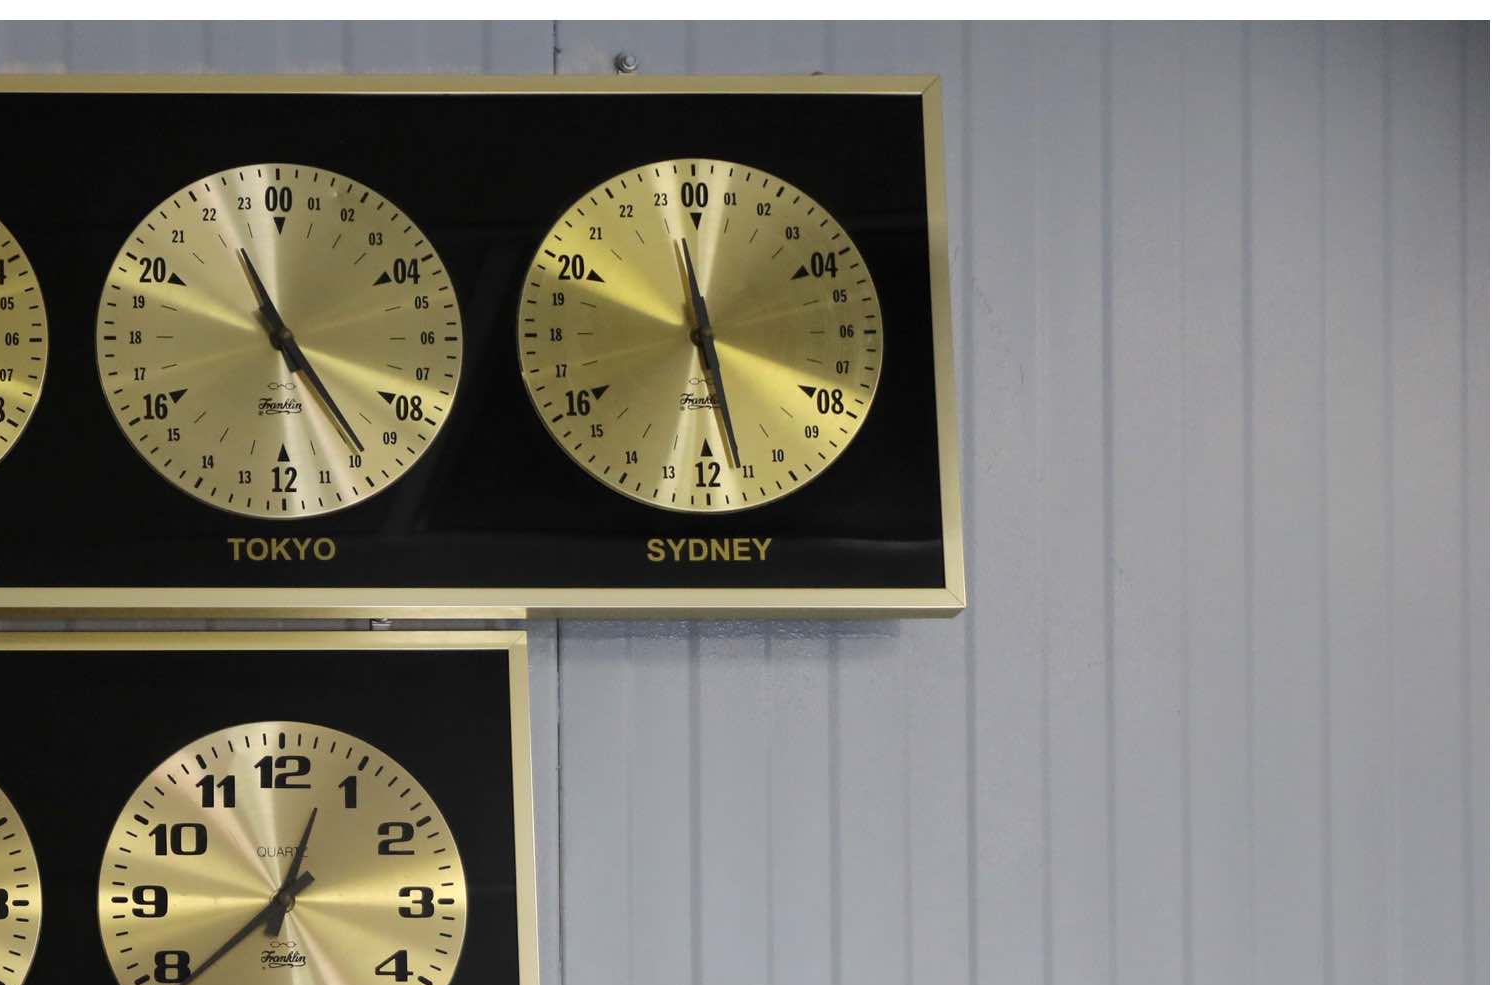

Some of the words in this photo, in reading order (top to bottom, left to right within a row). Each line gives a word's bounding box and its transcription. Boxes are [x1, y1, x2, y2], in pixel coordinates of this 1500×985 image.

[265, 186, 292, 212] 00
[681, 182, 708, 207] 00
[140, 257, 165, 282] 20
[394, 259, 420, 284] 04
[558, 255, 584, 280] 20
[811, 252, 838, 277] 04
[130, 331, 141, 344] 18
[421, 332, 434, 344] 06
[840, 325, 854, 338] 06
[144, 394, 167, 419] 16
[258, 397, 303, 415] Franklin
[396, 395, 422, 421] 08
[566, 390, 590, 416] 16
[817, 389, 843, 414] 08
[626, 451, 637, 464] 14
[272, 467, 297, 492] 12
[695, 462, 720, 487] 12
[228, 538, 335, 560] TOKYO
[648, 539, 771, 561] SYDNEY
[255, 756, 311, 789] 12
[196, 775, 235, 808] 11
[339, 776, 356, 808] 1
[149, 823, 207, 855] 10
[378, 822, 414, 855] 2
[132, 885, 167, 918] 9
[399, 887, 434, 918] 3
[154, 950, 191, 984] 8
[261, 950, 306, 968] Franklin
[375, 950, 413, 982] 4
